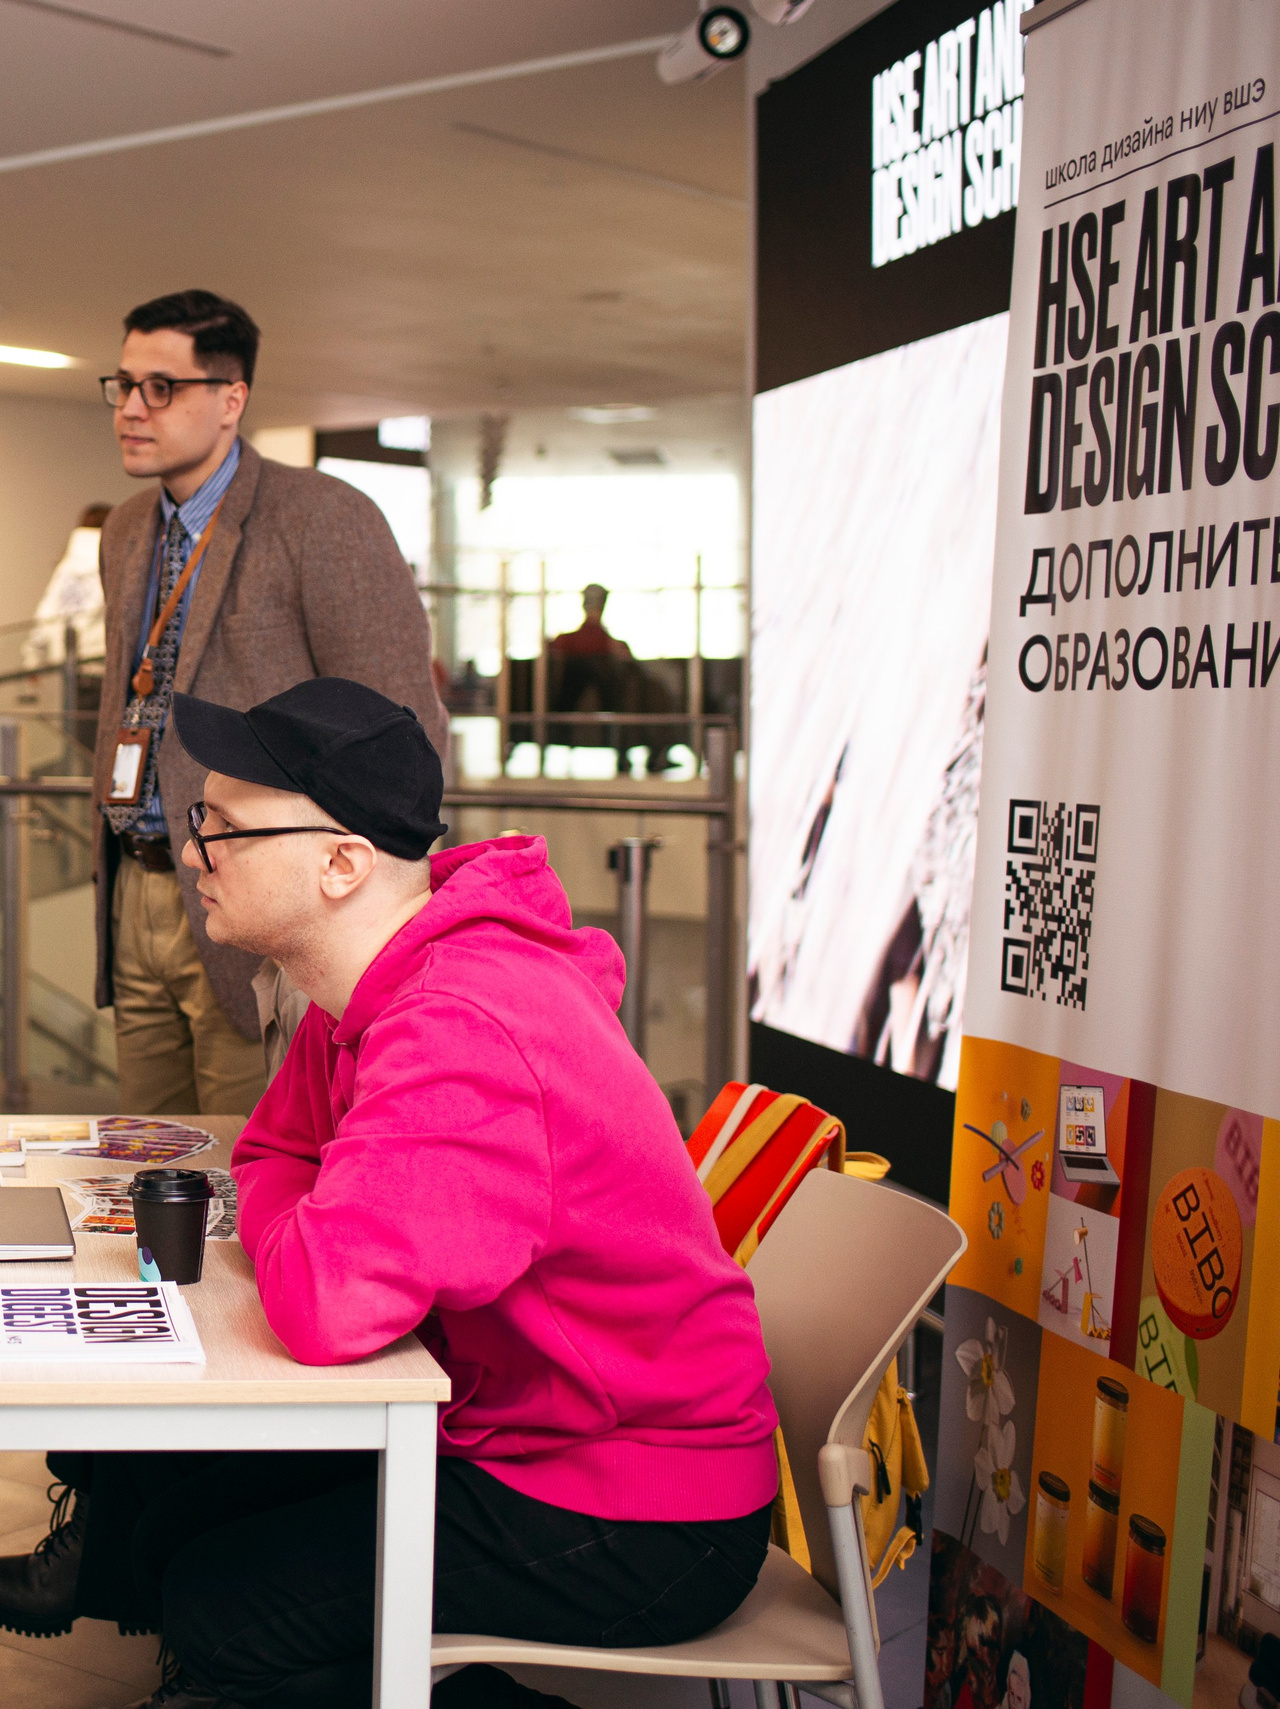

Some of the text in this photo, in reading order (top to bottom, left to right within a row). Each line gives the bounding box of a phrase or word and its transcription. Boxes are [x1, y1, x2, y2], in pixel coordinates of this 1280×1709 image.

[872, 50, 921, 170] HSE
[922, 17, 976, 146] ART
[1045, 150, 1097, 190] школа
[1101, 116, 1173, 172] дизайна
[872, 129, 962, 268] DESIGN
[1033, 141, 1280, 370] HSE ART A
[1024, 310, 1280, 515] DESIGN SC
[1, 1288, 77, 1334] DIGEST
[73, 1287, 175, 1343] DESIGN
[1172, 1183, 1232, 1320] BIBO
